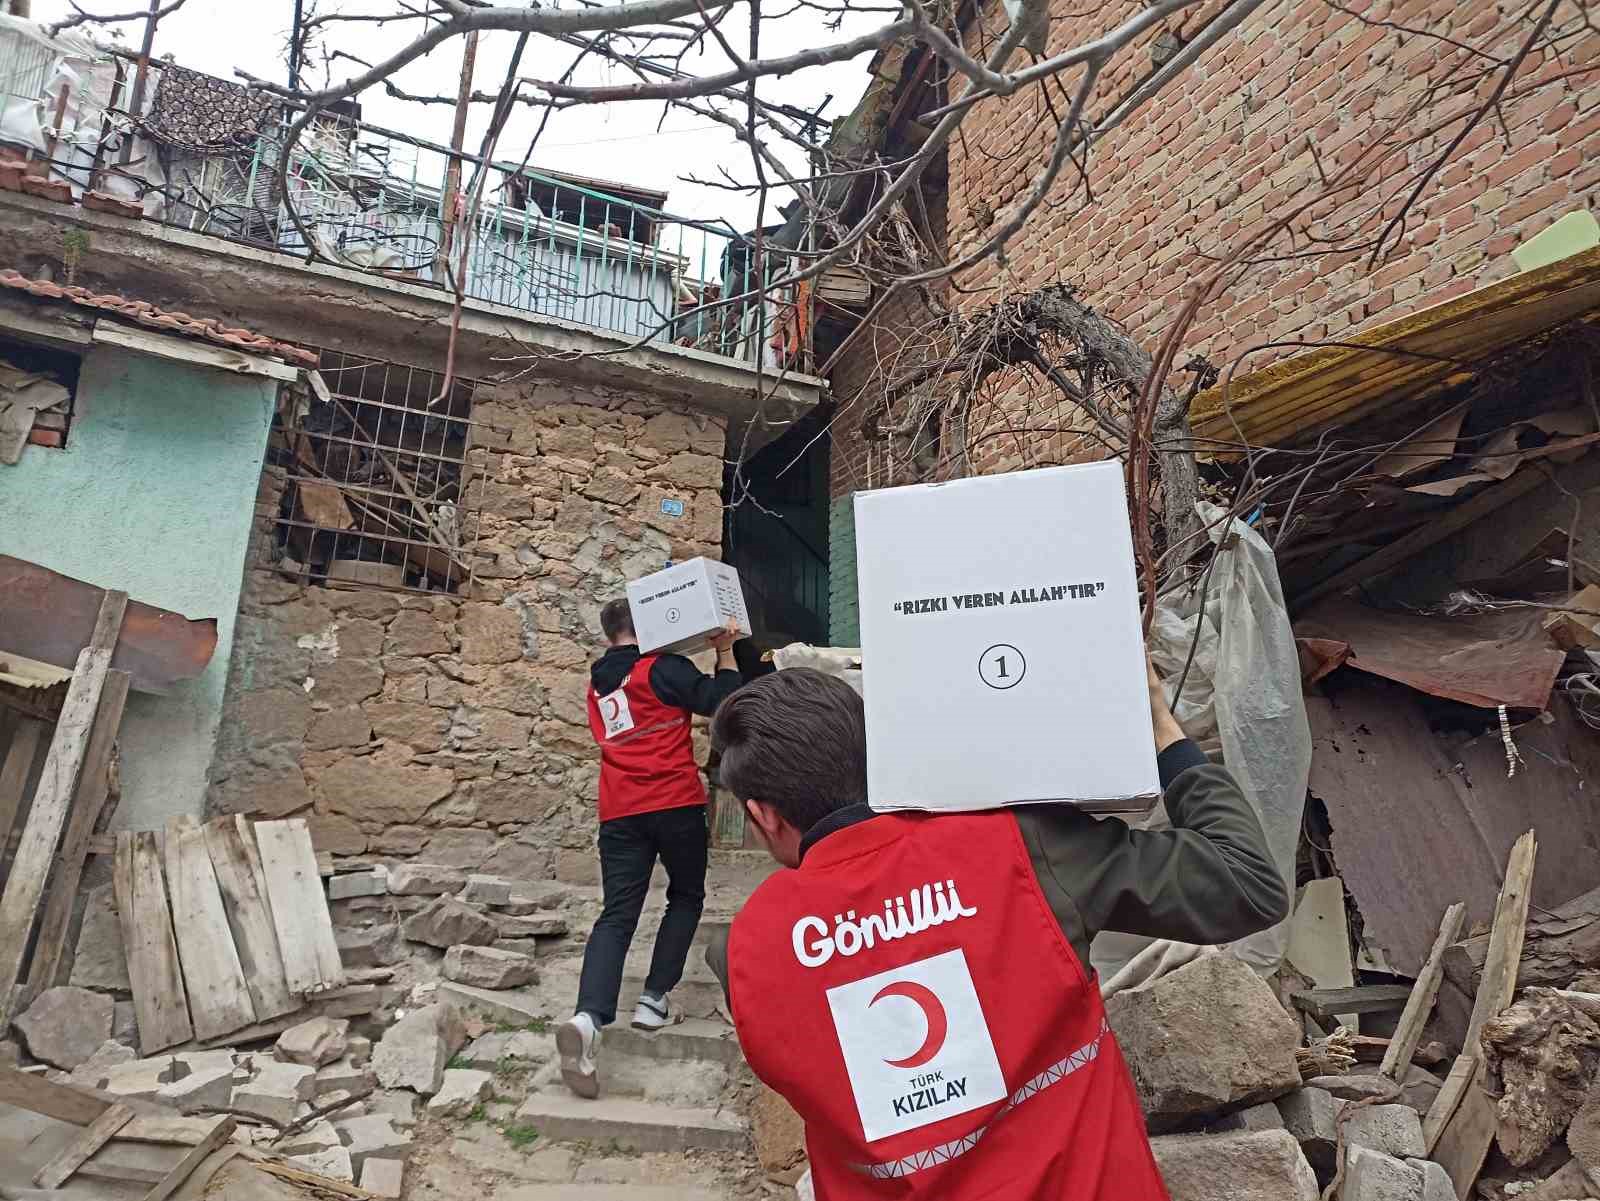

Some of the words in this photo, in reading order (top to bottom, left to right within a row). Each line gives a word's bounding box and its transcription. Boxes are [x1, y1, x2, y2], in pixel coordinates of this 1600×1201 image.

[894, 597, 948, 615] “RIZKI
[952, 591, 1005, 609] VEREN
[994, 655, 1010, 678] 1
[792, 879, 977, 968] Gönüllü
[909, 1070, 944, 1089] TÜRK
[892, 1077, 968, 1117] KIZILAY
